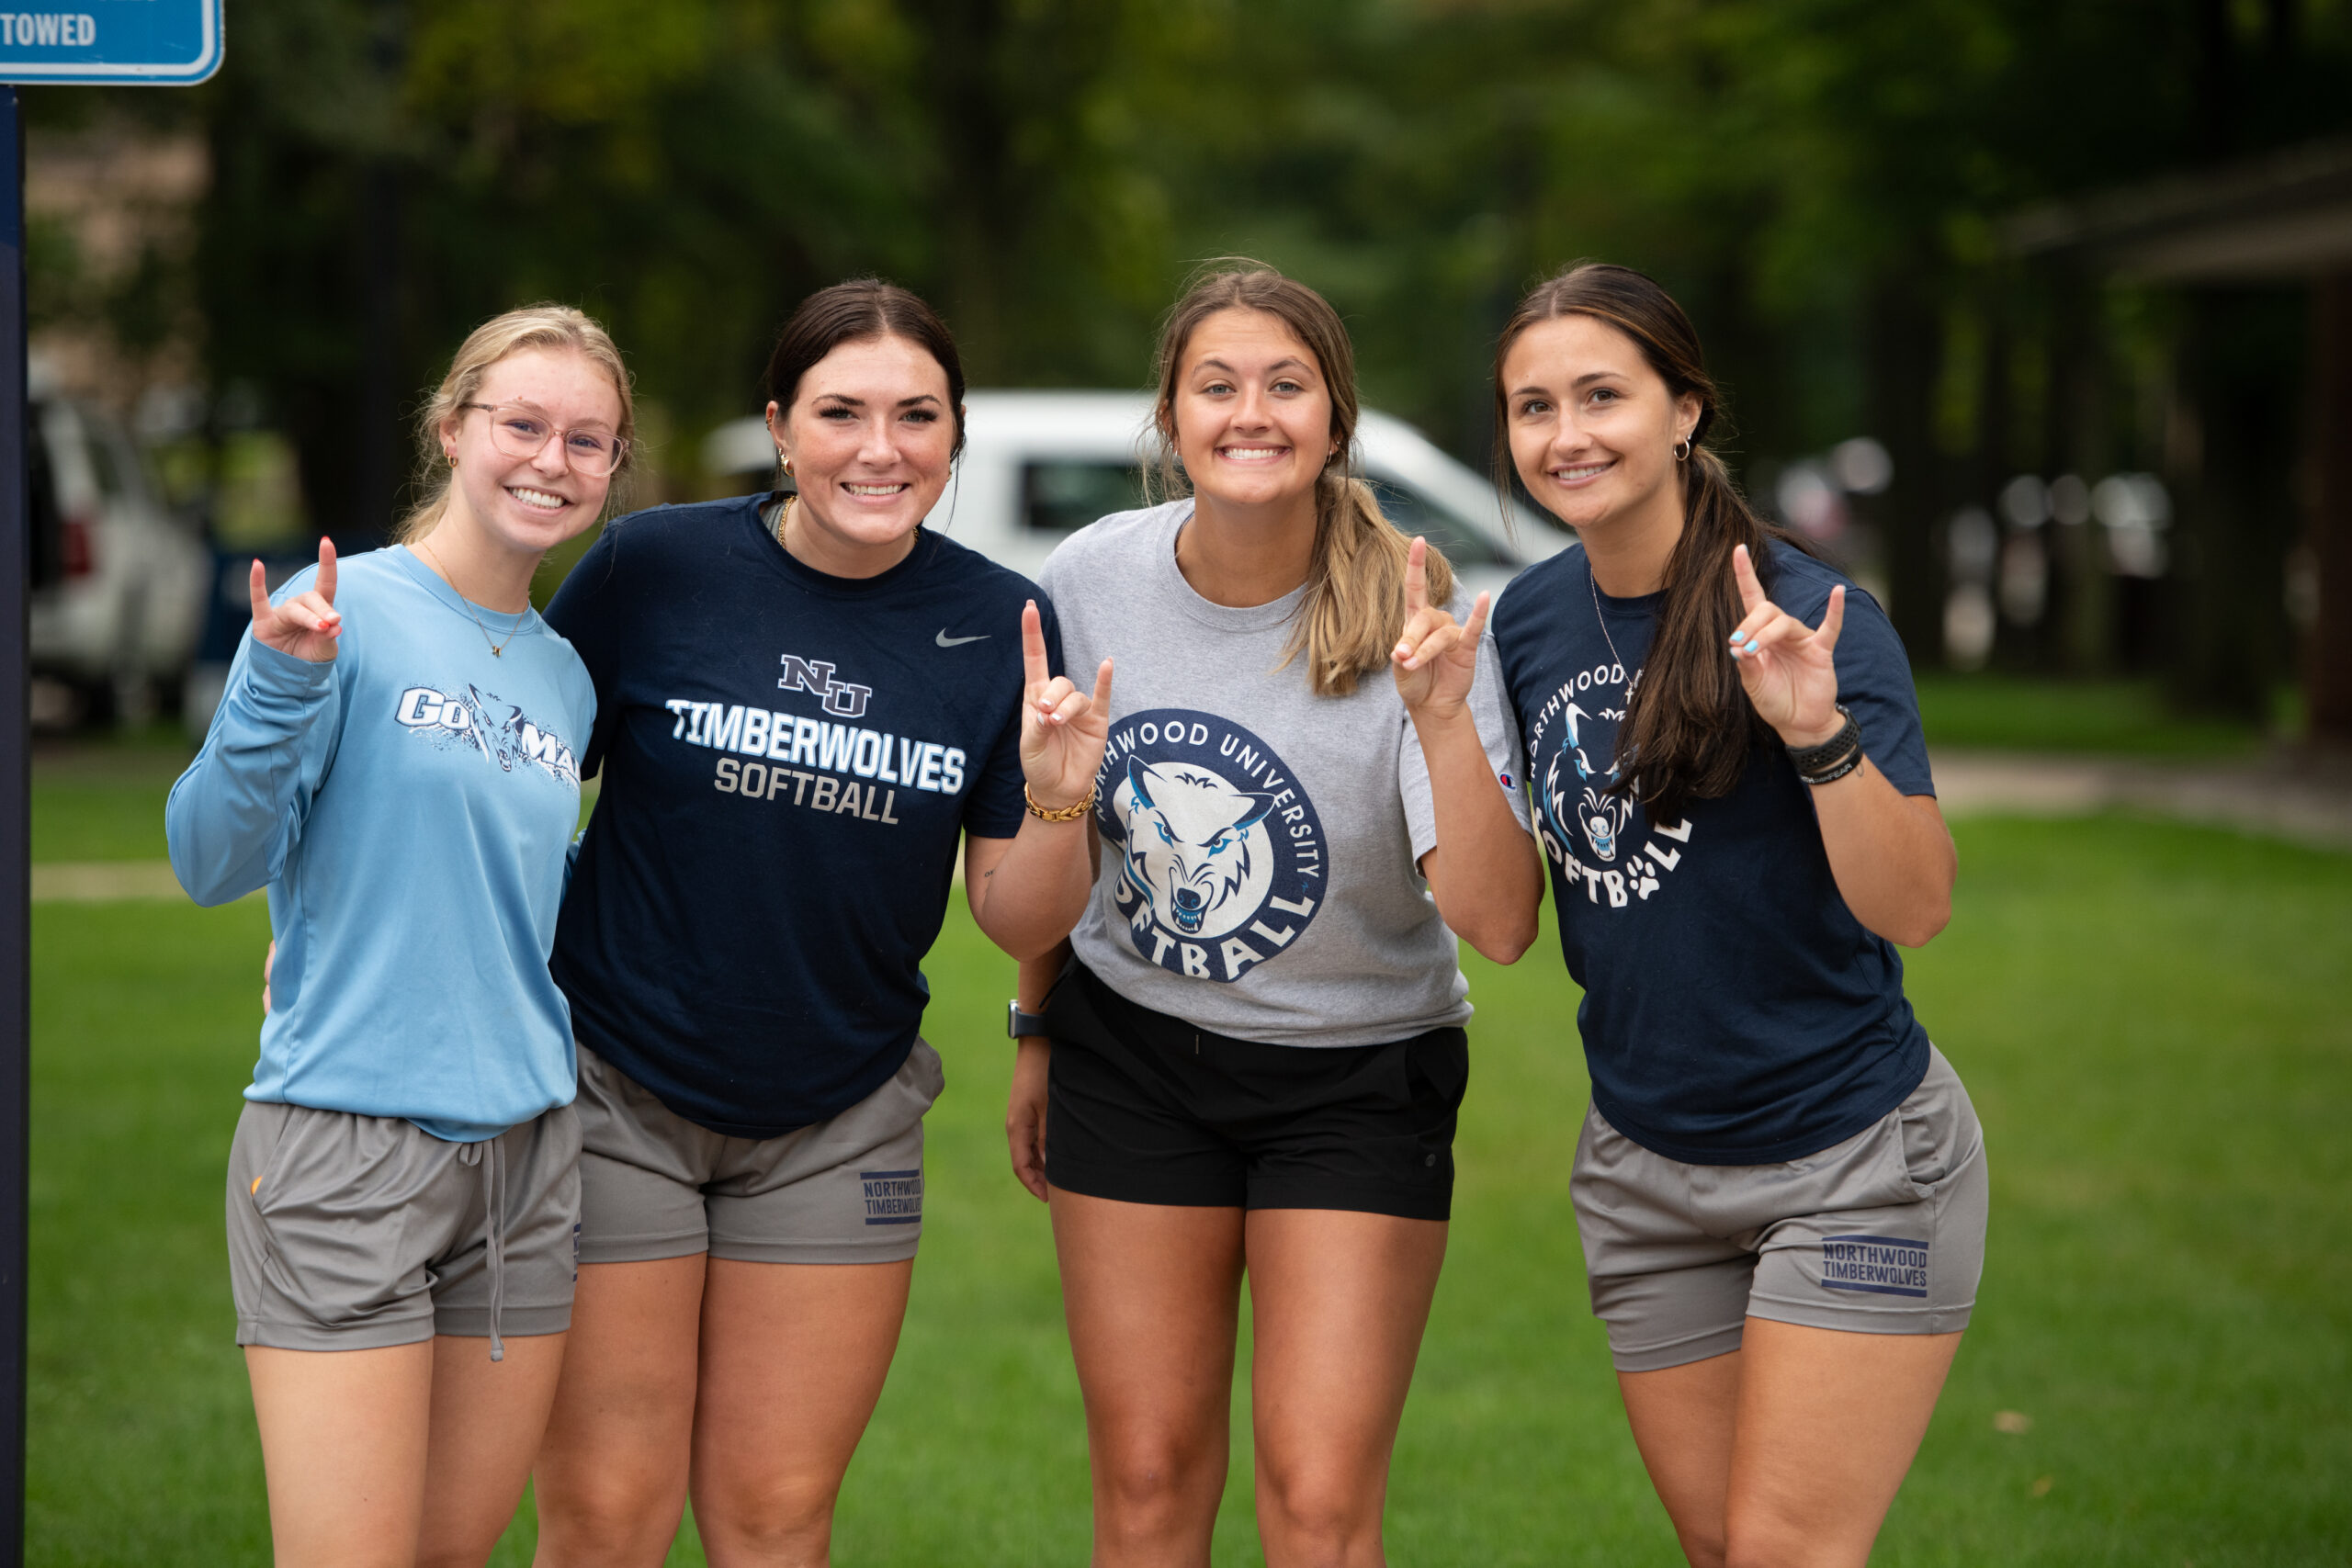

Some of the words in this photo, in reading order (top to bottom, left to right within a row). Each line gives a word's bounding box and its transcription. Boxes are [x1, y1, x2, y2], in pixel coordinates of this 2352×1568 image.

[0, 13, 96, 46] TOWED
[778, 654, 872, 718] NU
[665, 699, 966, 795] TIMBERWOLVES
[1531, 663, 1624, 779] NORTHWOOD
[714, 758, 899, 825] SOFTBALL
[1219, 734, 1319, 879] UNIVERSITY
[1823, 1243, 1928, 1269] NORTHWOOD
[1823, 1260, 1927, 1287] TIMBERWOLVES
